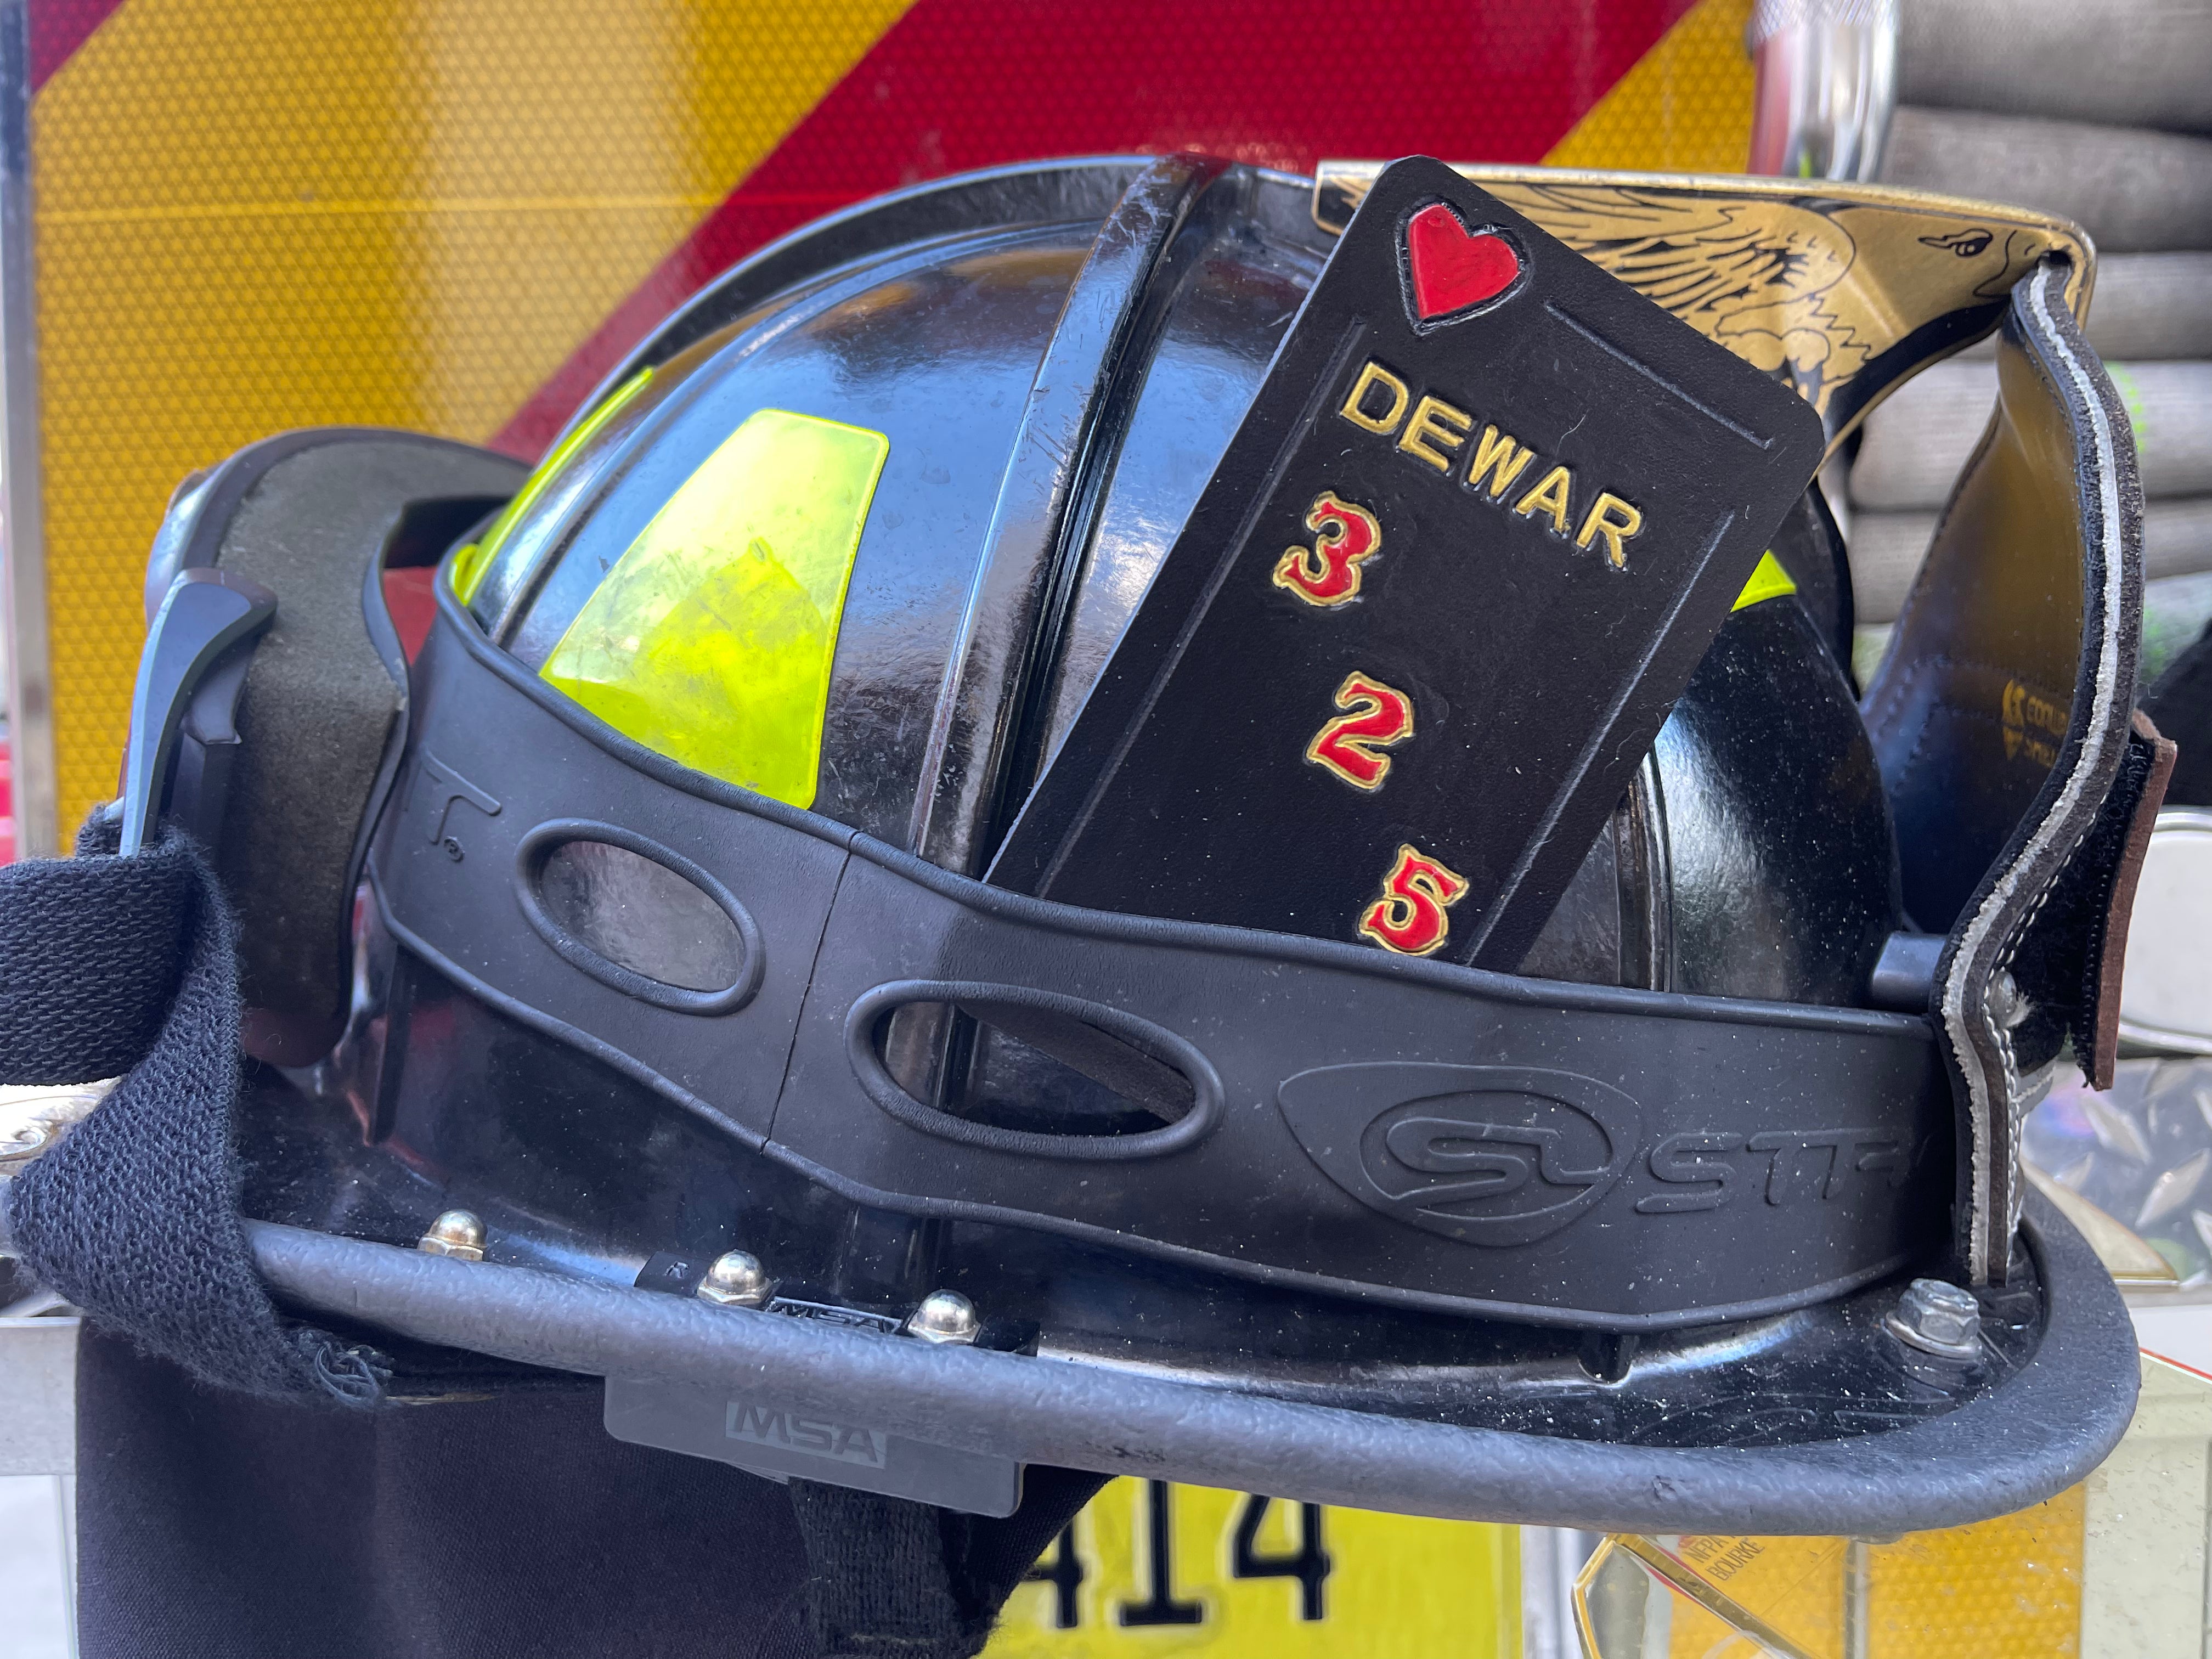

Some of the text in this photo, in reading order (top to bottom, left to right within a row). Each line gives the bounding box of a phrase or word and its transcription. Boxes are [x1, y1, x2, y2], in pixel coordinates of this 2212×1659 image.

[1339, 360, 1641, 569] DEWAR
[1272, 490, 1382, 607] 3
[1306, 670, 1414, 791] 2
[1358, 843, 1469, 956] 5
[733, 1400, 878, 1463] MSA
[1705, 1536, 1765, 1581] BOURKE
